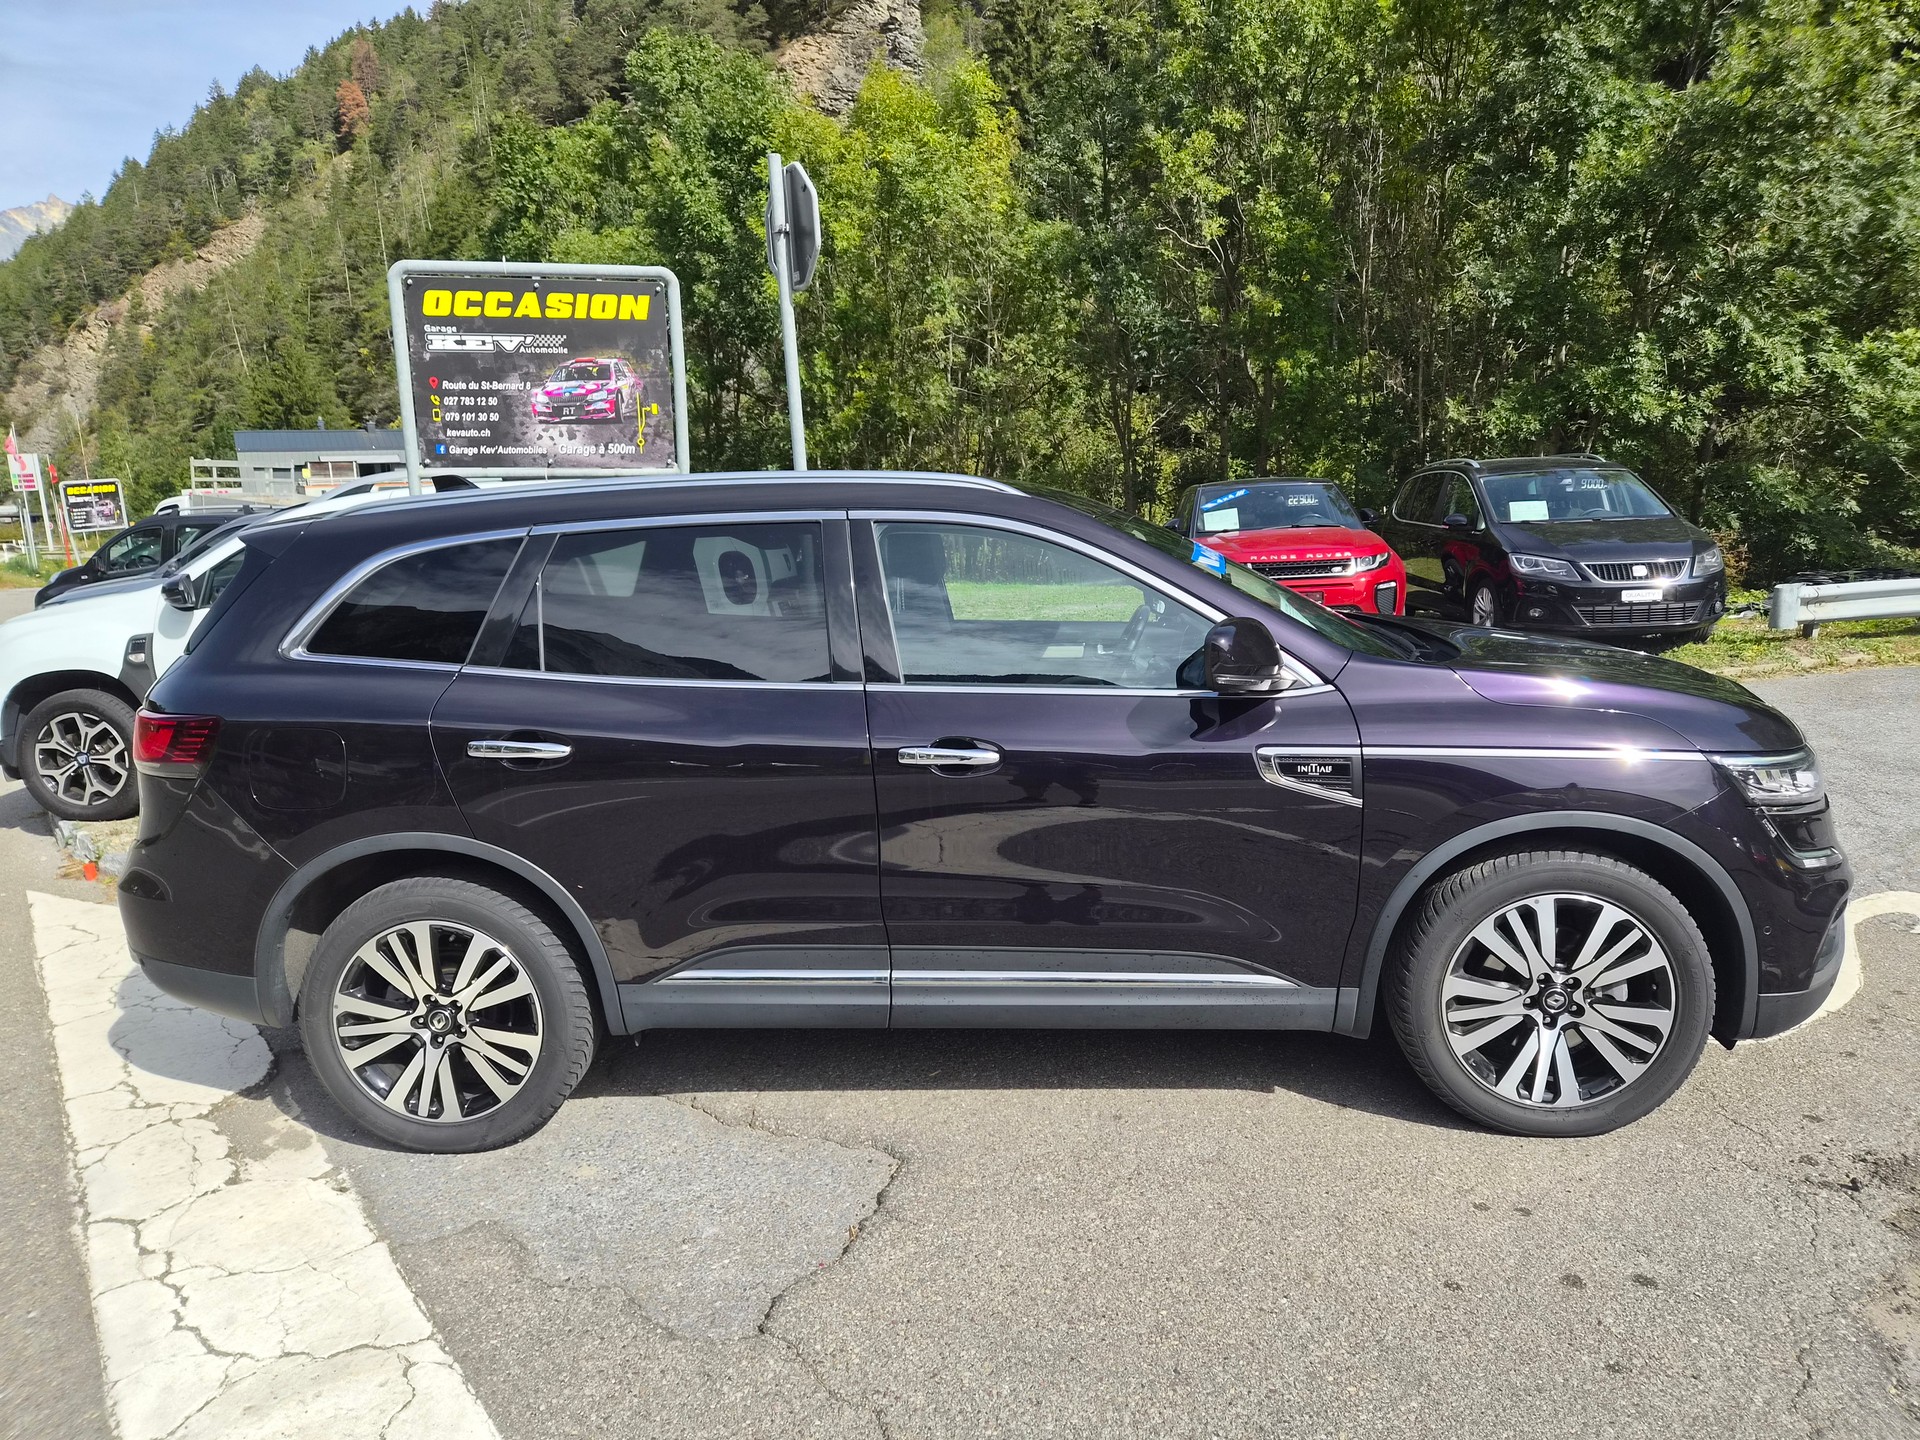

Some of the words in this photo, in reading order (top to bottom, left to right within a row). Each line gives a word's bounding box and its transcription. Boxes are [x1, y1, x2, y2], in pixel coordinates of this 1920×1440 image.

[422, 289, 650, 320] OCCASION
[424, 325, 457, 333] Garage
[519, 346, 568, 354] Automobile
[442, 381, 467, 390] Route
[468, 381, 479, 390] du
[480, 381, 524, 390] St-Bernard
[526, 381, 531, 390] 8
[443, 397, 457, 405] 027
[460, 397, 475, 405] 783
[476, 397, 487, 405] 12
[488, 397, 498, 405] 50
[562, 407, 576, 415] RT
[445, 413, 460, 421] 079
[462, 413, 475, 421] 101
[478, 413, 488, 421] 30
[489, 413, 499, 421] 50
[446, 428, 491, 437] kevauto.ch
[449, 446, 478, 456] Garage
[480, 445, 547, 455] Kev'Automobiles
[558, 443, 596, 456] Garage
[599, 443, 605, 454] à
[608, 443, 636, 454] 500m
[66, 484, 116, 495] OCCASION
